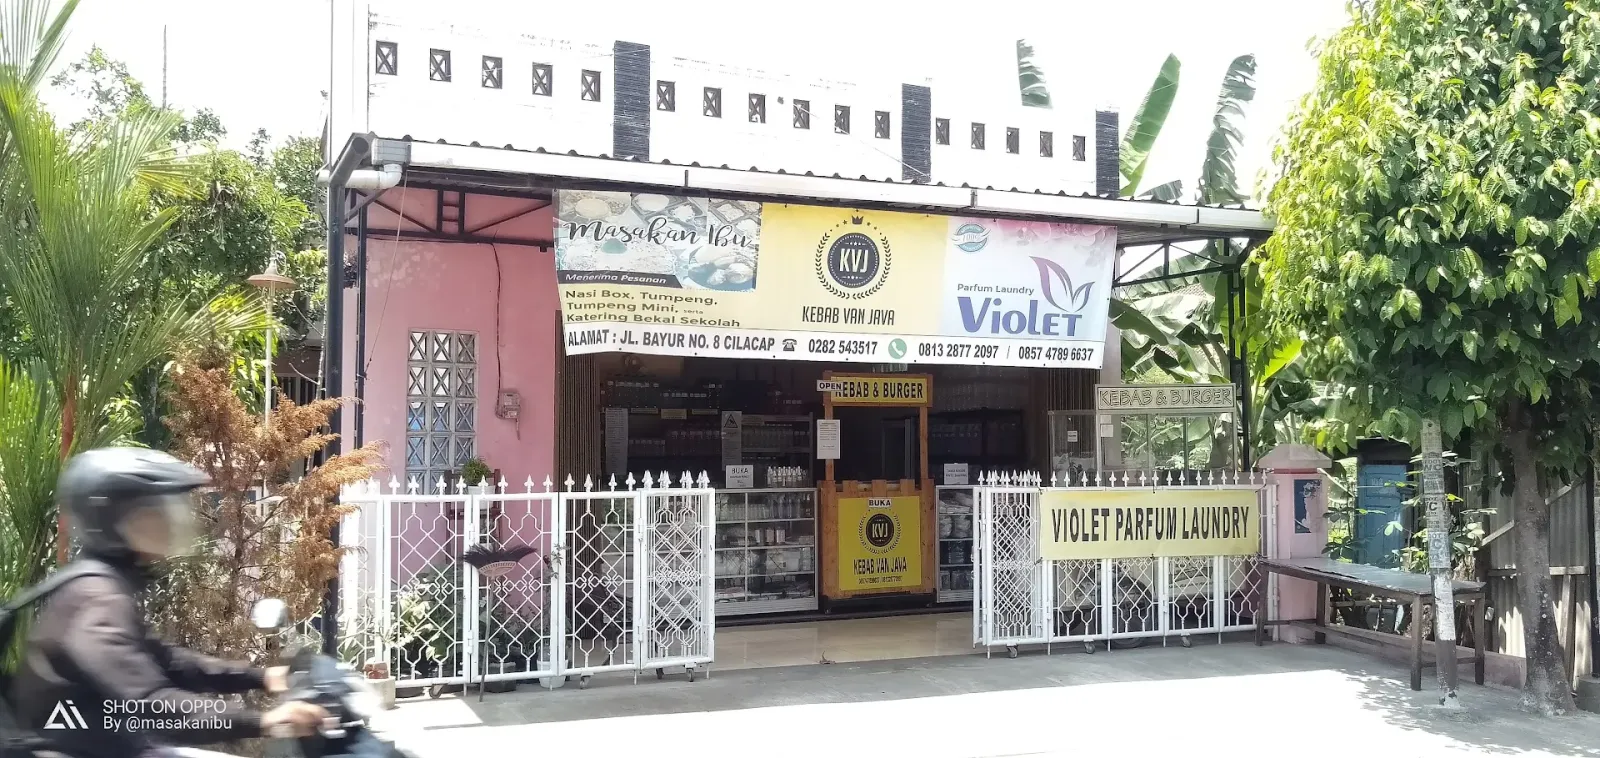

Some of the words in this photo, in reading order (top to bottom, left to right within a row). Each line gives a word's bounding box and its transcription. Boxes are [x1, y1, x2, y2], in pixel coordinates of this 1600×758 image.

[562, 217, 700, 245] Masakan
[708, 224, 753, 248] Ibu
[839, 248, 869, 274] KVJ
[566, 273, 618, 282] Menerima
[620, 274, 667, 285] Pesanan
[566, 290, 596, 299] Nasi
[640, 292, 718, 305] Tumpeng,
[957, 283, 993, 294] Parfum
[995, 285, 1035, 297] Laundry
[566, 301, 637, 313] Tumpeng
[642, 303, 679, 313] Mini,
[566, 312, 628, 324] Katering
[633, 314, 675, 324] Bekal
[680, 316, 740, 327] Sekolah
[802, 306, 839, 324] KEBAB
[842, 307, 866, 325] VAN
[867, 308, 895, 326] JAVA
[568, 329, 609, 347] ALAMAT
[620, 331, 639, 345] JL.
[643, 331, 685, 347] BAYUR
[688, 333, 709, 349] NO.
[713, 335, 720, 349] 8
[724, 335, 775, 351] CILACAP
[808, 339, 837, 354] 0282
[838, 340, 878, 355] 543517
[918, 342, 944, 357] 0813
[946, 343, 972, 358] 2877
[974, 344, 999, 359] 2097
[1018, 346, 1044, 361] 0857
[1045, 347, 1069, 361] 4789
[1070, 347, 1094, 362] 6637
[819, 382, 842, 390] OPEN
[873, 382, 879, 398] &
[883, 383, 923, 398] BURGER
[1099, 389, 1151, 406] KEBAB
[1156, 389, 1168, 405] &
[1170, 388, 1233, 405] BURGER
[872, 522, 888, 538] KVJ
[1051, 508, 1110, 543] VIOLET
[1115, 507, 1177, 541] PARFUM
[1182, 506, 1250, 540] LAUNDRY
[854, 559, 874, 575] KEBAB
[876, 558, 889, 573] VAN
[891, 557, 907, 572] JAVA
